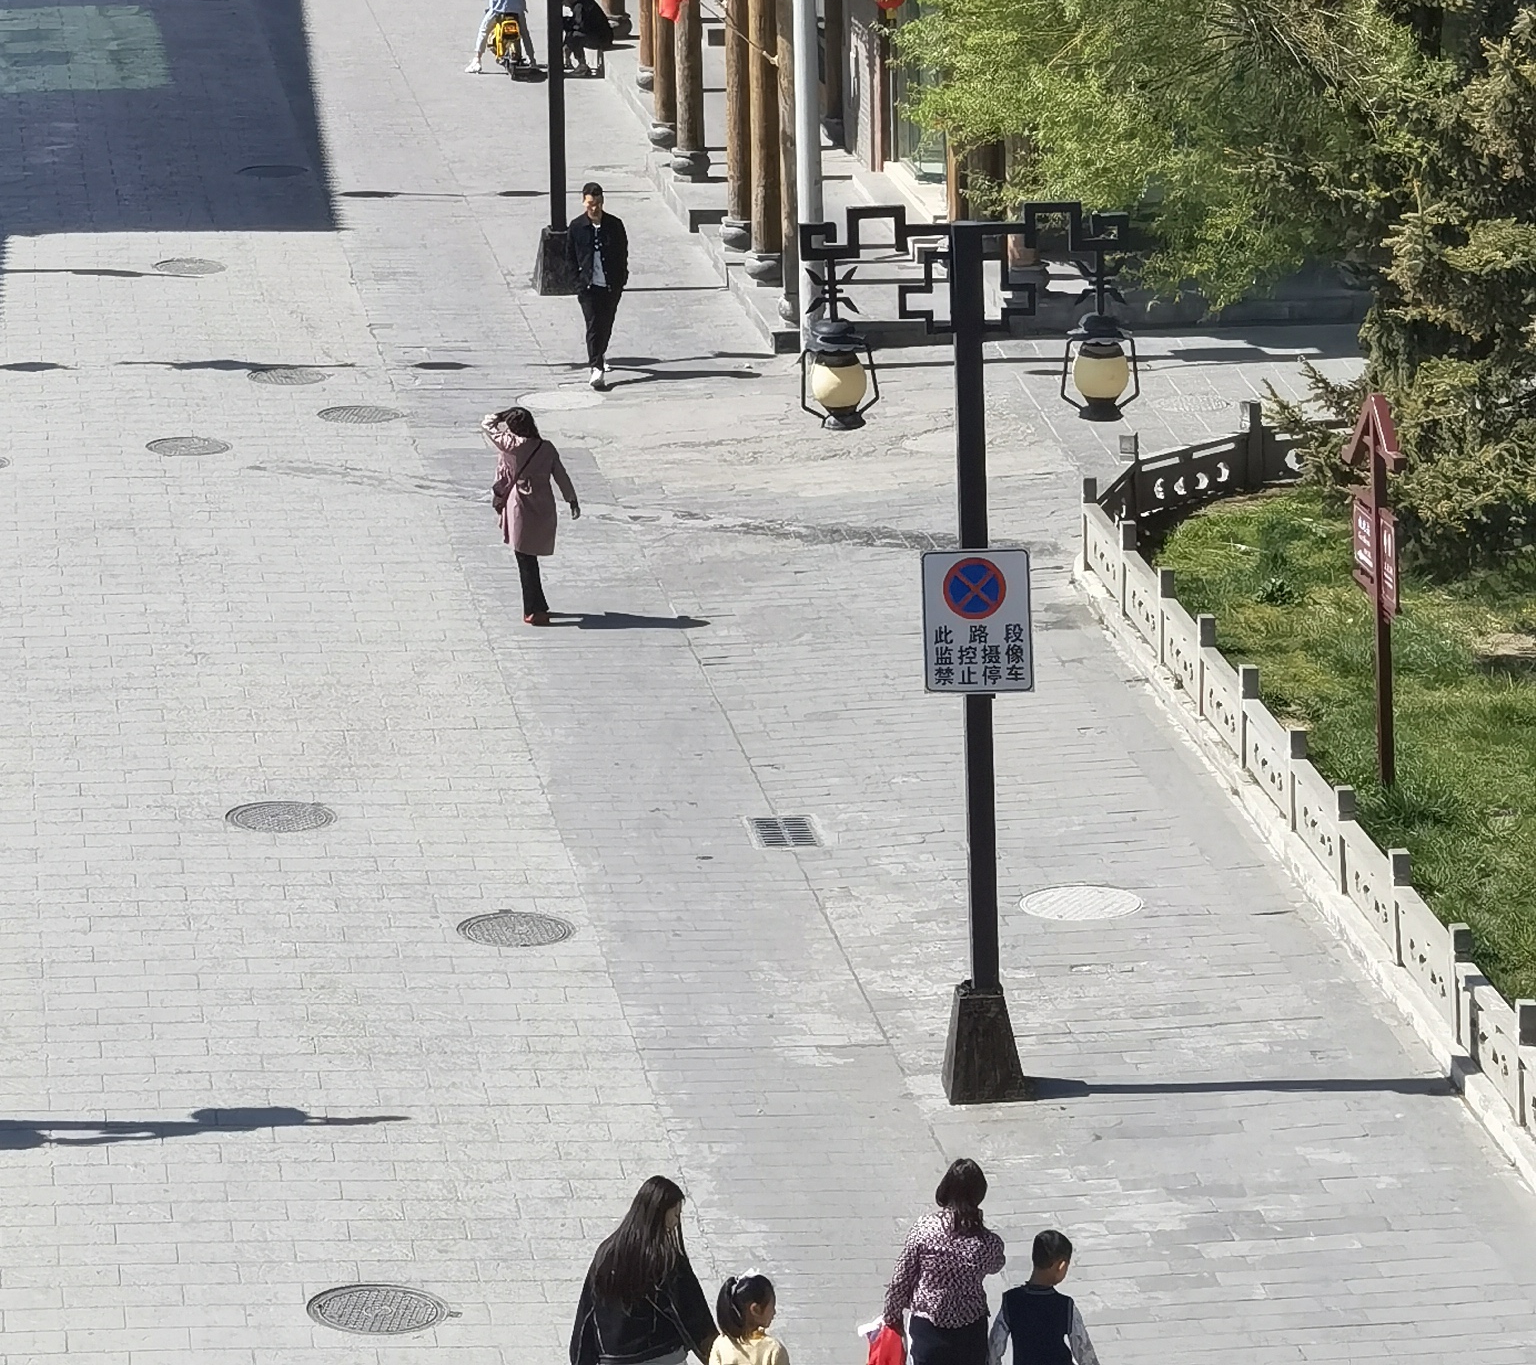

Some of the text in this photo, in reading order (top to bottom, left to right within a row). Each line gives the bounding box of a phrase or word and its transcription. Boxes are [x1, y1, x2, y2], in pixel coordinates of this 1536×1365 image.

[934, 623, 1024, 645] 此路段
[934, 644, 1025, 666] 监控摄像
[934, 665, 1026, 686] 禁止停车
